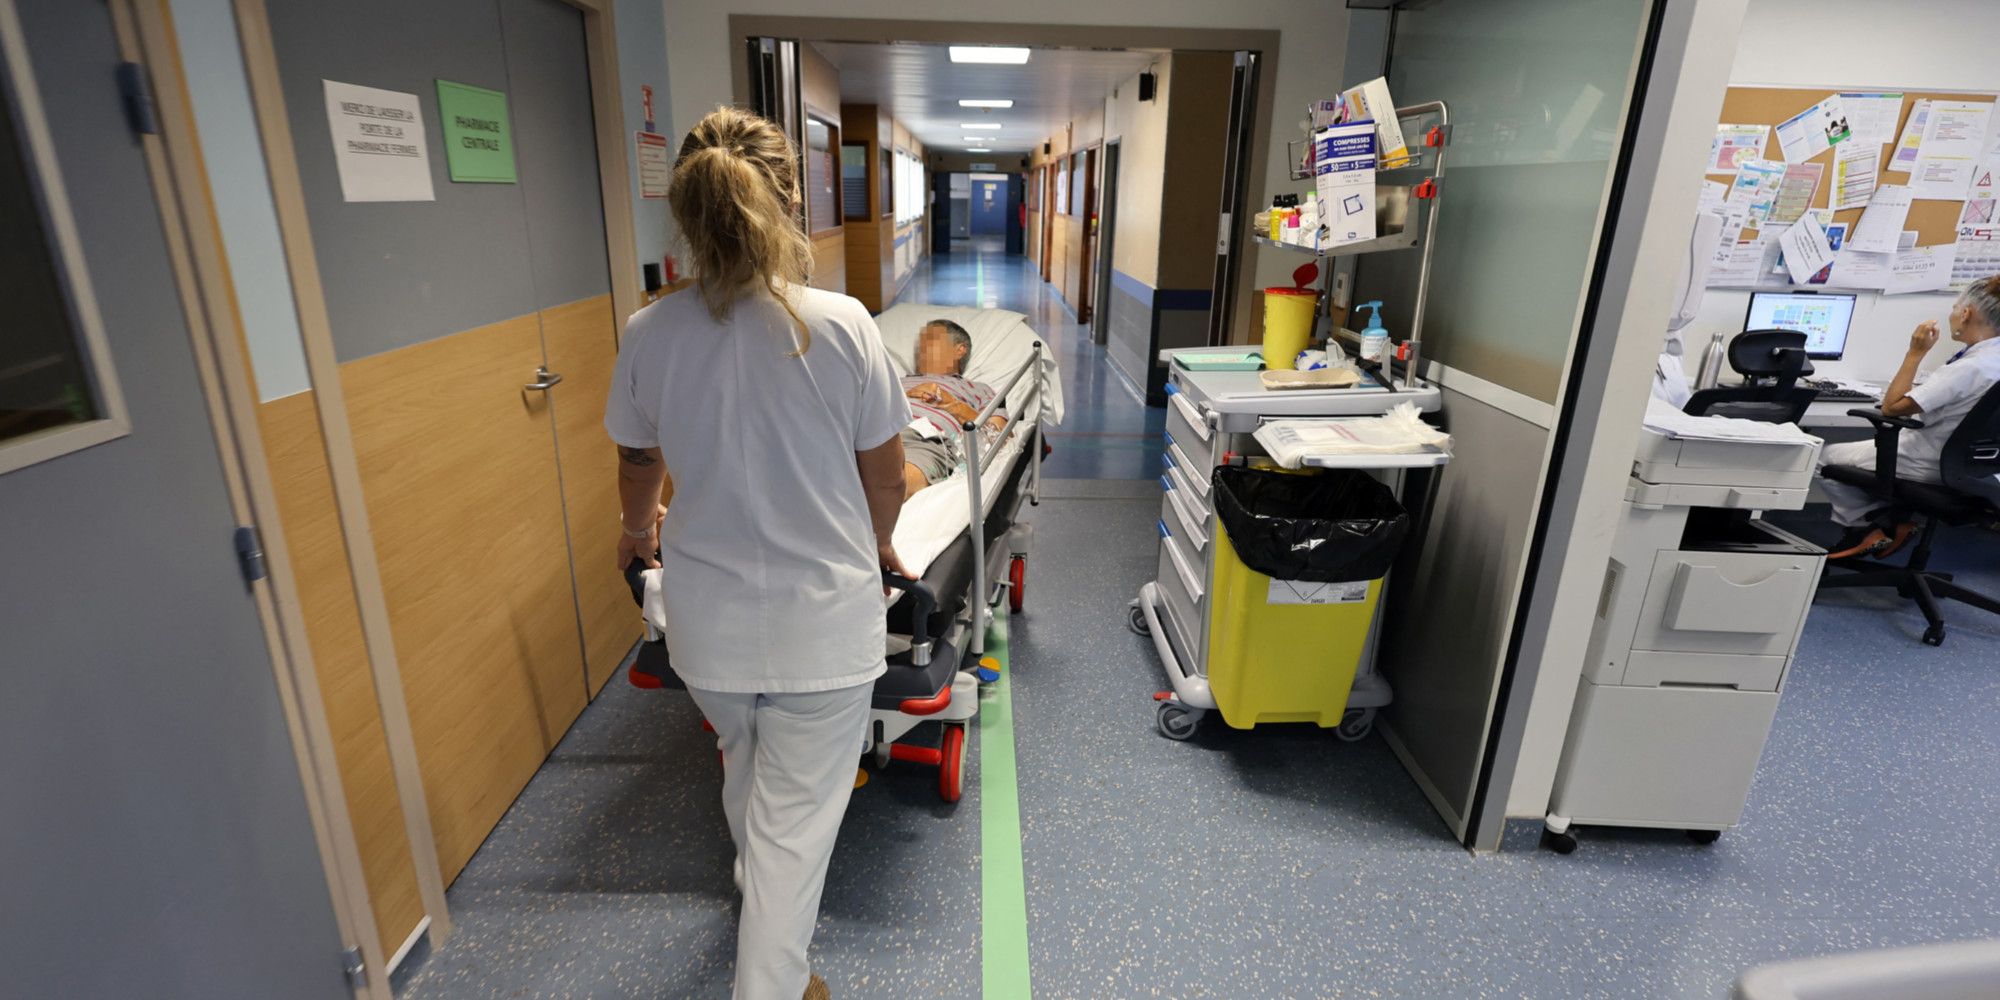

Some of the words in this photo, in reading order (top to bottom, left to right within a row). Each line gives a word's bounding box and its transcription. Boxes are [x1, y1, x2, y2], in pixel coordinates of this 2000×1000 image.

[340, 101, 364, 114] MERCI
[365, 105, 376, 116] DE
[378, 107, 404, 119] LAISSER
[359, 122, 382, 134] PORTE
[455, 115, 500, 133] PHARMACIE
[347, 140, 389, 153] PHARMACIE
[462, 136, 500, 151] CENTRALE
[1333, 136, 1370, 146] COMPRESSES
[1331, 163, 1339, 171] 50
